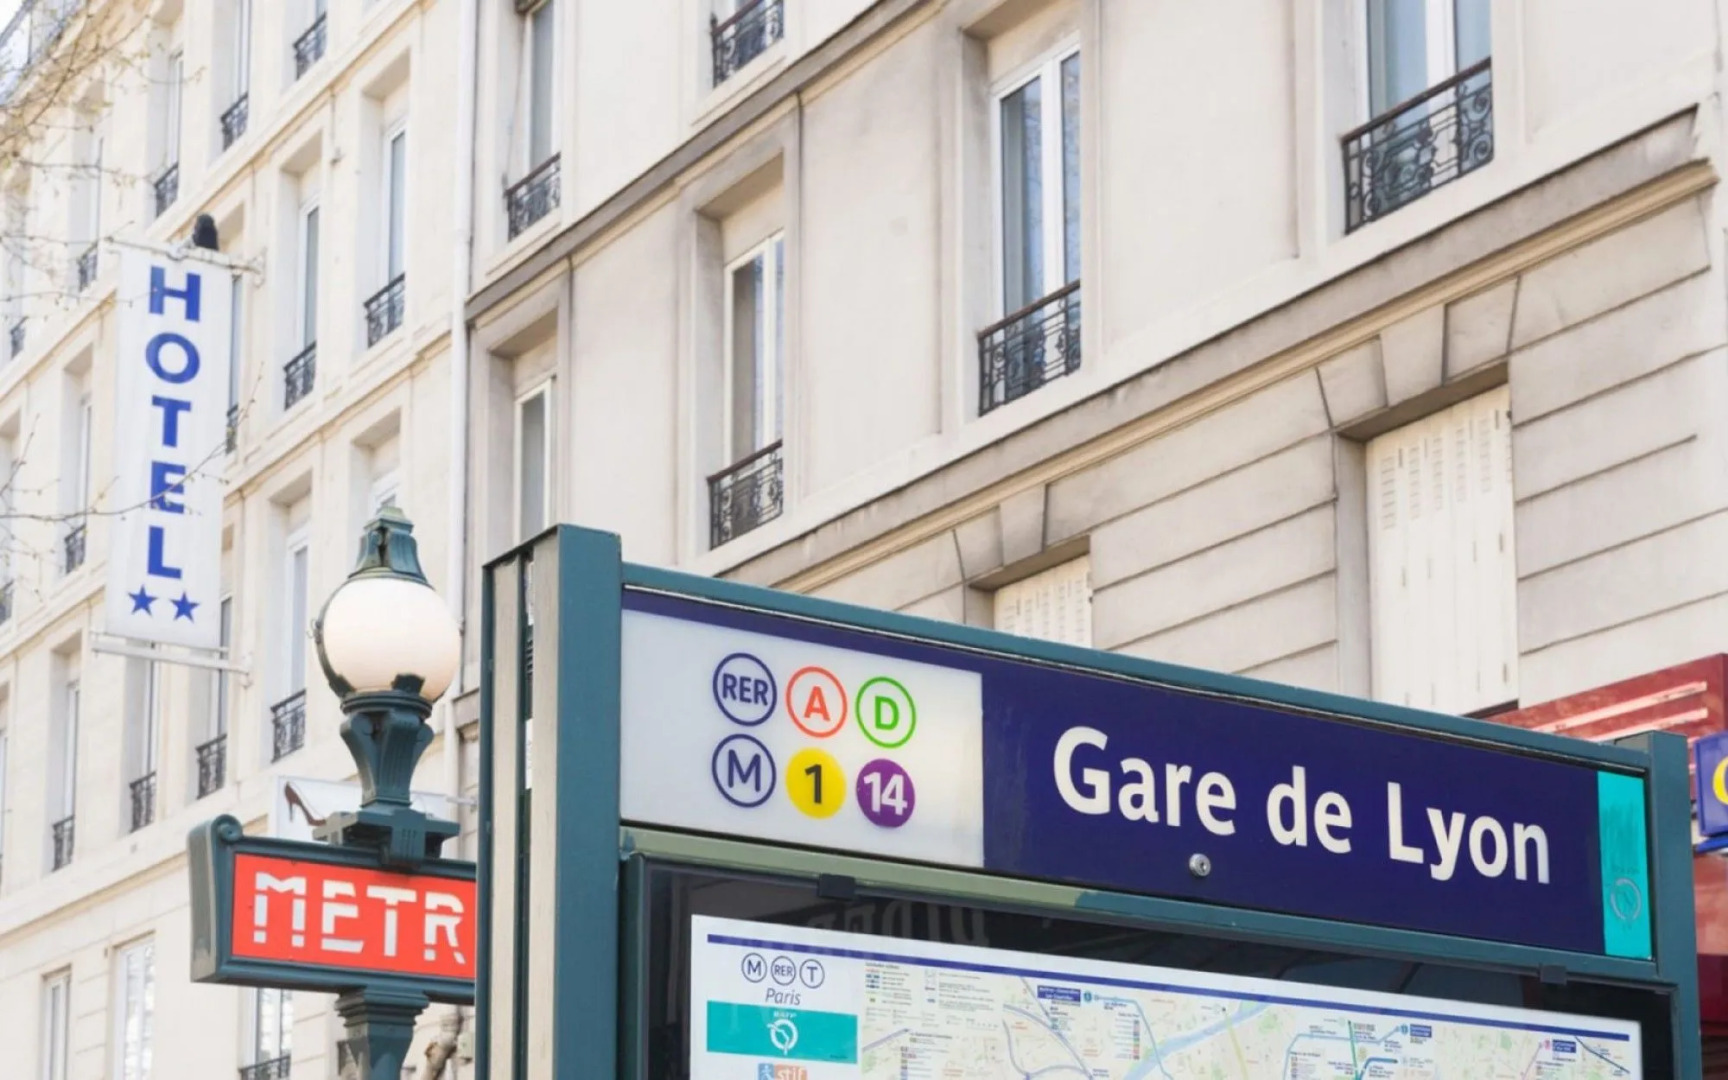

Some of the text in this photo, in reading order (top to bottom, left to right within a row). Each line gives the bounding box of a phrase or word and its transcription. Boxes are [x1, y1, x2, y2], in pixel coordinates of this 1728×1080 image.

[146, 265, 201, 579] HOTEL
[722, 673, 900, 731] RER A D
[728, 749, 907, 816] M 1 14
[1053, 726, 1550, 884] Gare de Lyon
[254, 871, 466, 964] METR
[747, 960, 818, 983] M RER T
[765, 988, 801, 1006] Paris
